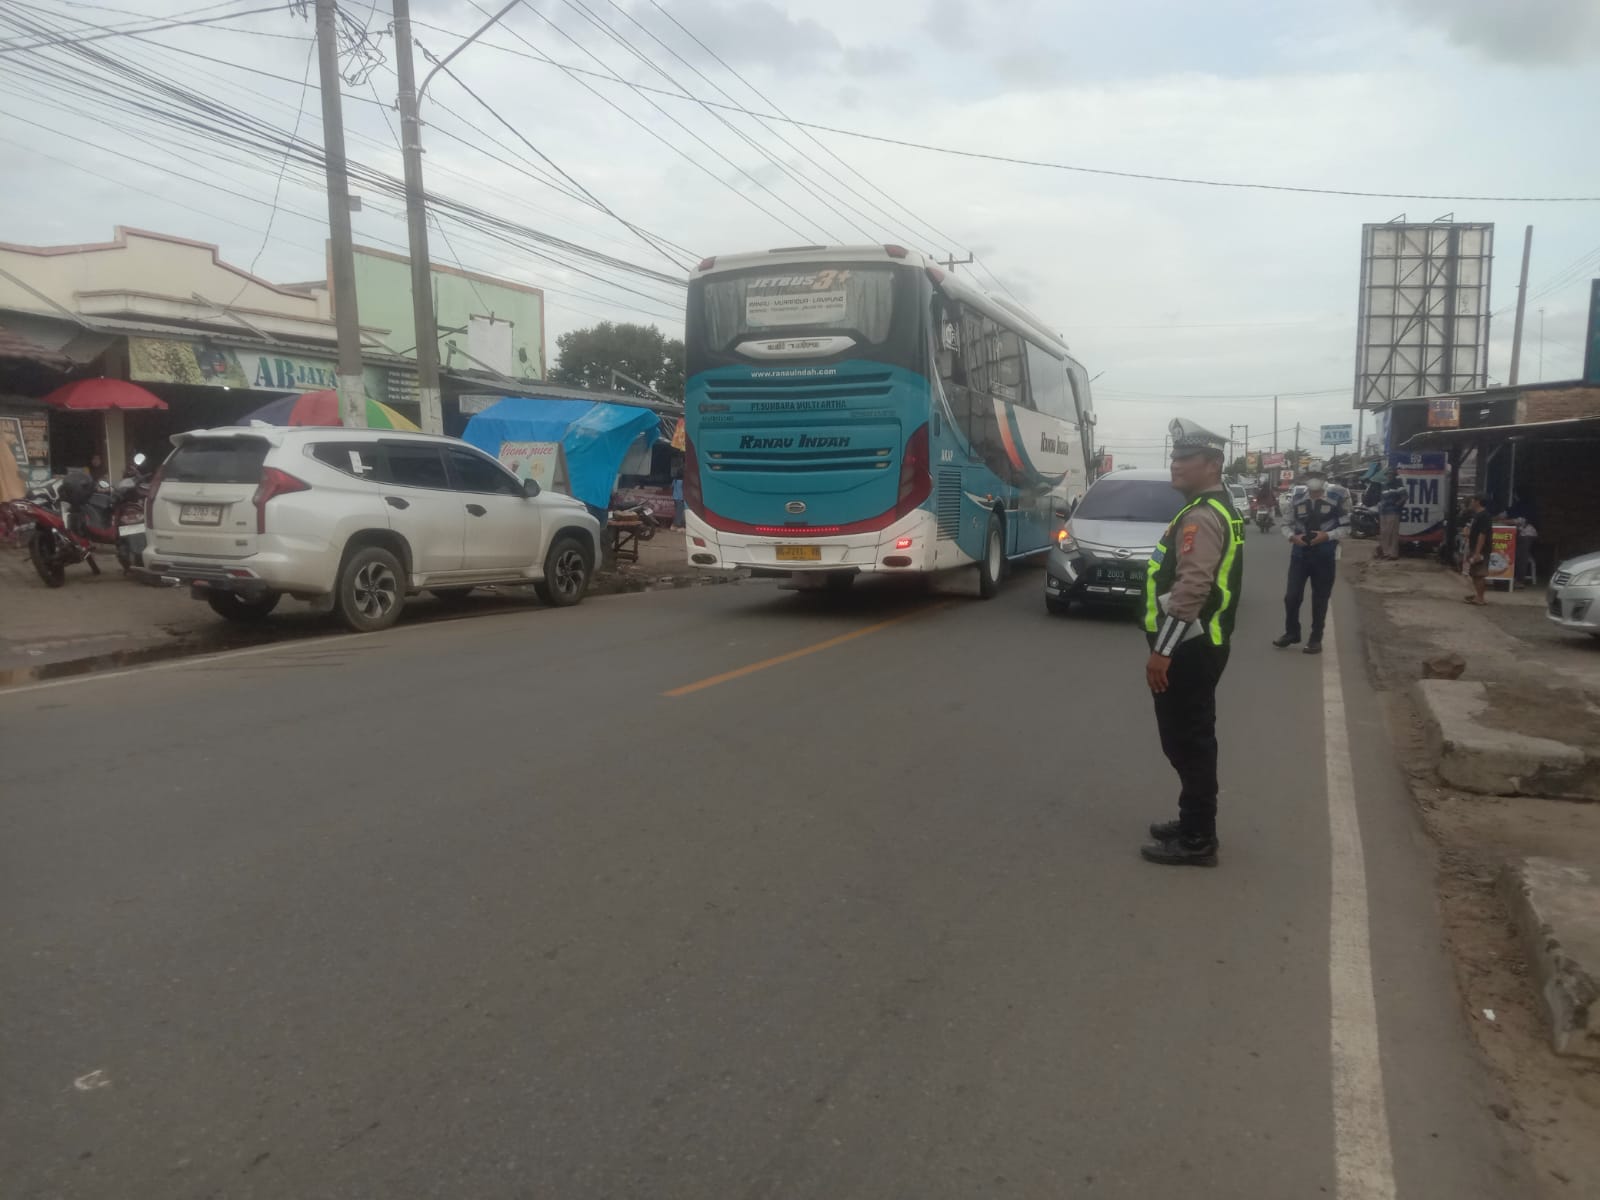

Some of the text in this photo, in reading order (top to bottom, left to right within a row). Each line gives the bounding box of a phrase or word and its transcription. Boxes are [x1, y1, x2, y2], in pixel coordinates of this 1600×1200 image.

[751, 368, 837, 378] www.ranauindah.com
[740, 432, 851, 449] RANAU INDAH
[1324, 431, 1350, 440] ATM
